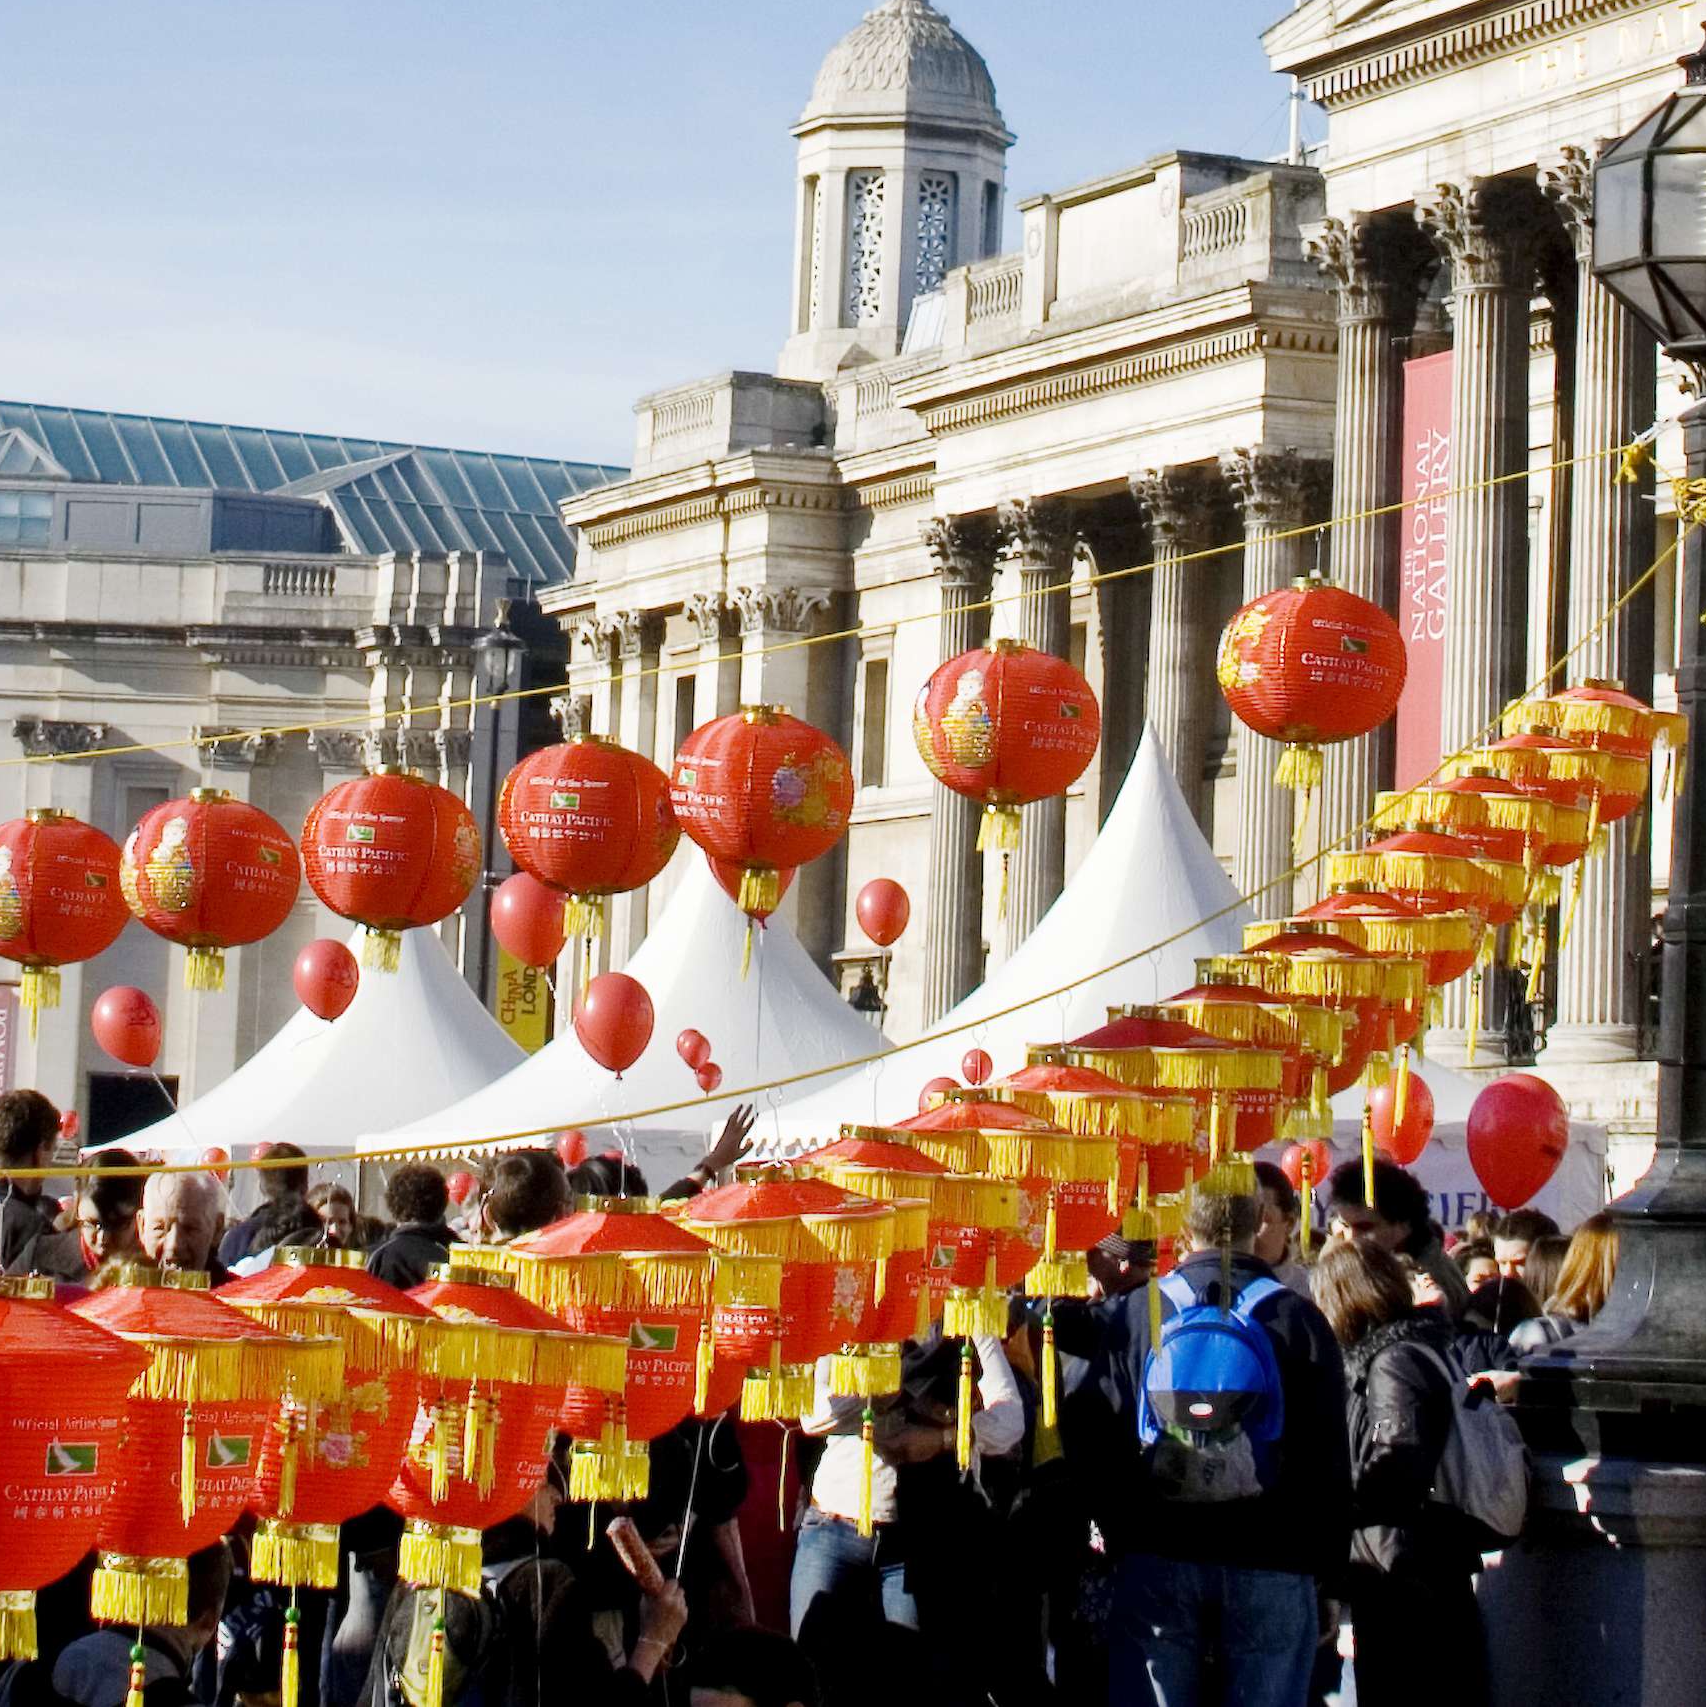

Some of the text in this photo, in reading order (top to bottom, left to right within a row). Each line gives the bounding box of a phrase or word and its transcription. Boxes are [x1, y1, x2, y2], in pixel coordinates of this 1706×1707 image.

[1411, 428, 1434, 641] NATIONAL
[520, 811, 613, 827] CATHAY PACIFIC
[318, 845, 360, 859] CATHAY
[521, 965, 538, 1015] LOND
[12, 1416, 59, 1431] Official
[4, 1484, 72, 1503] CATHAY
